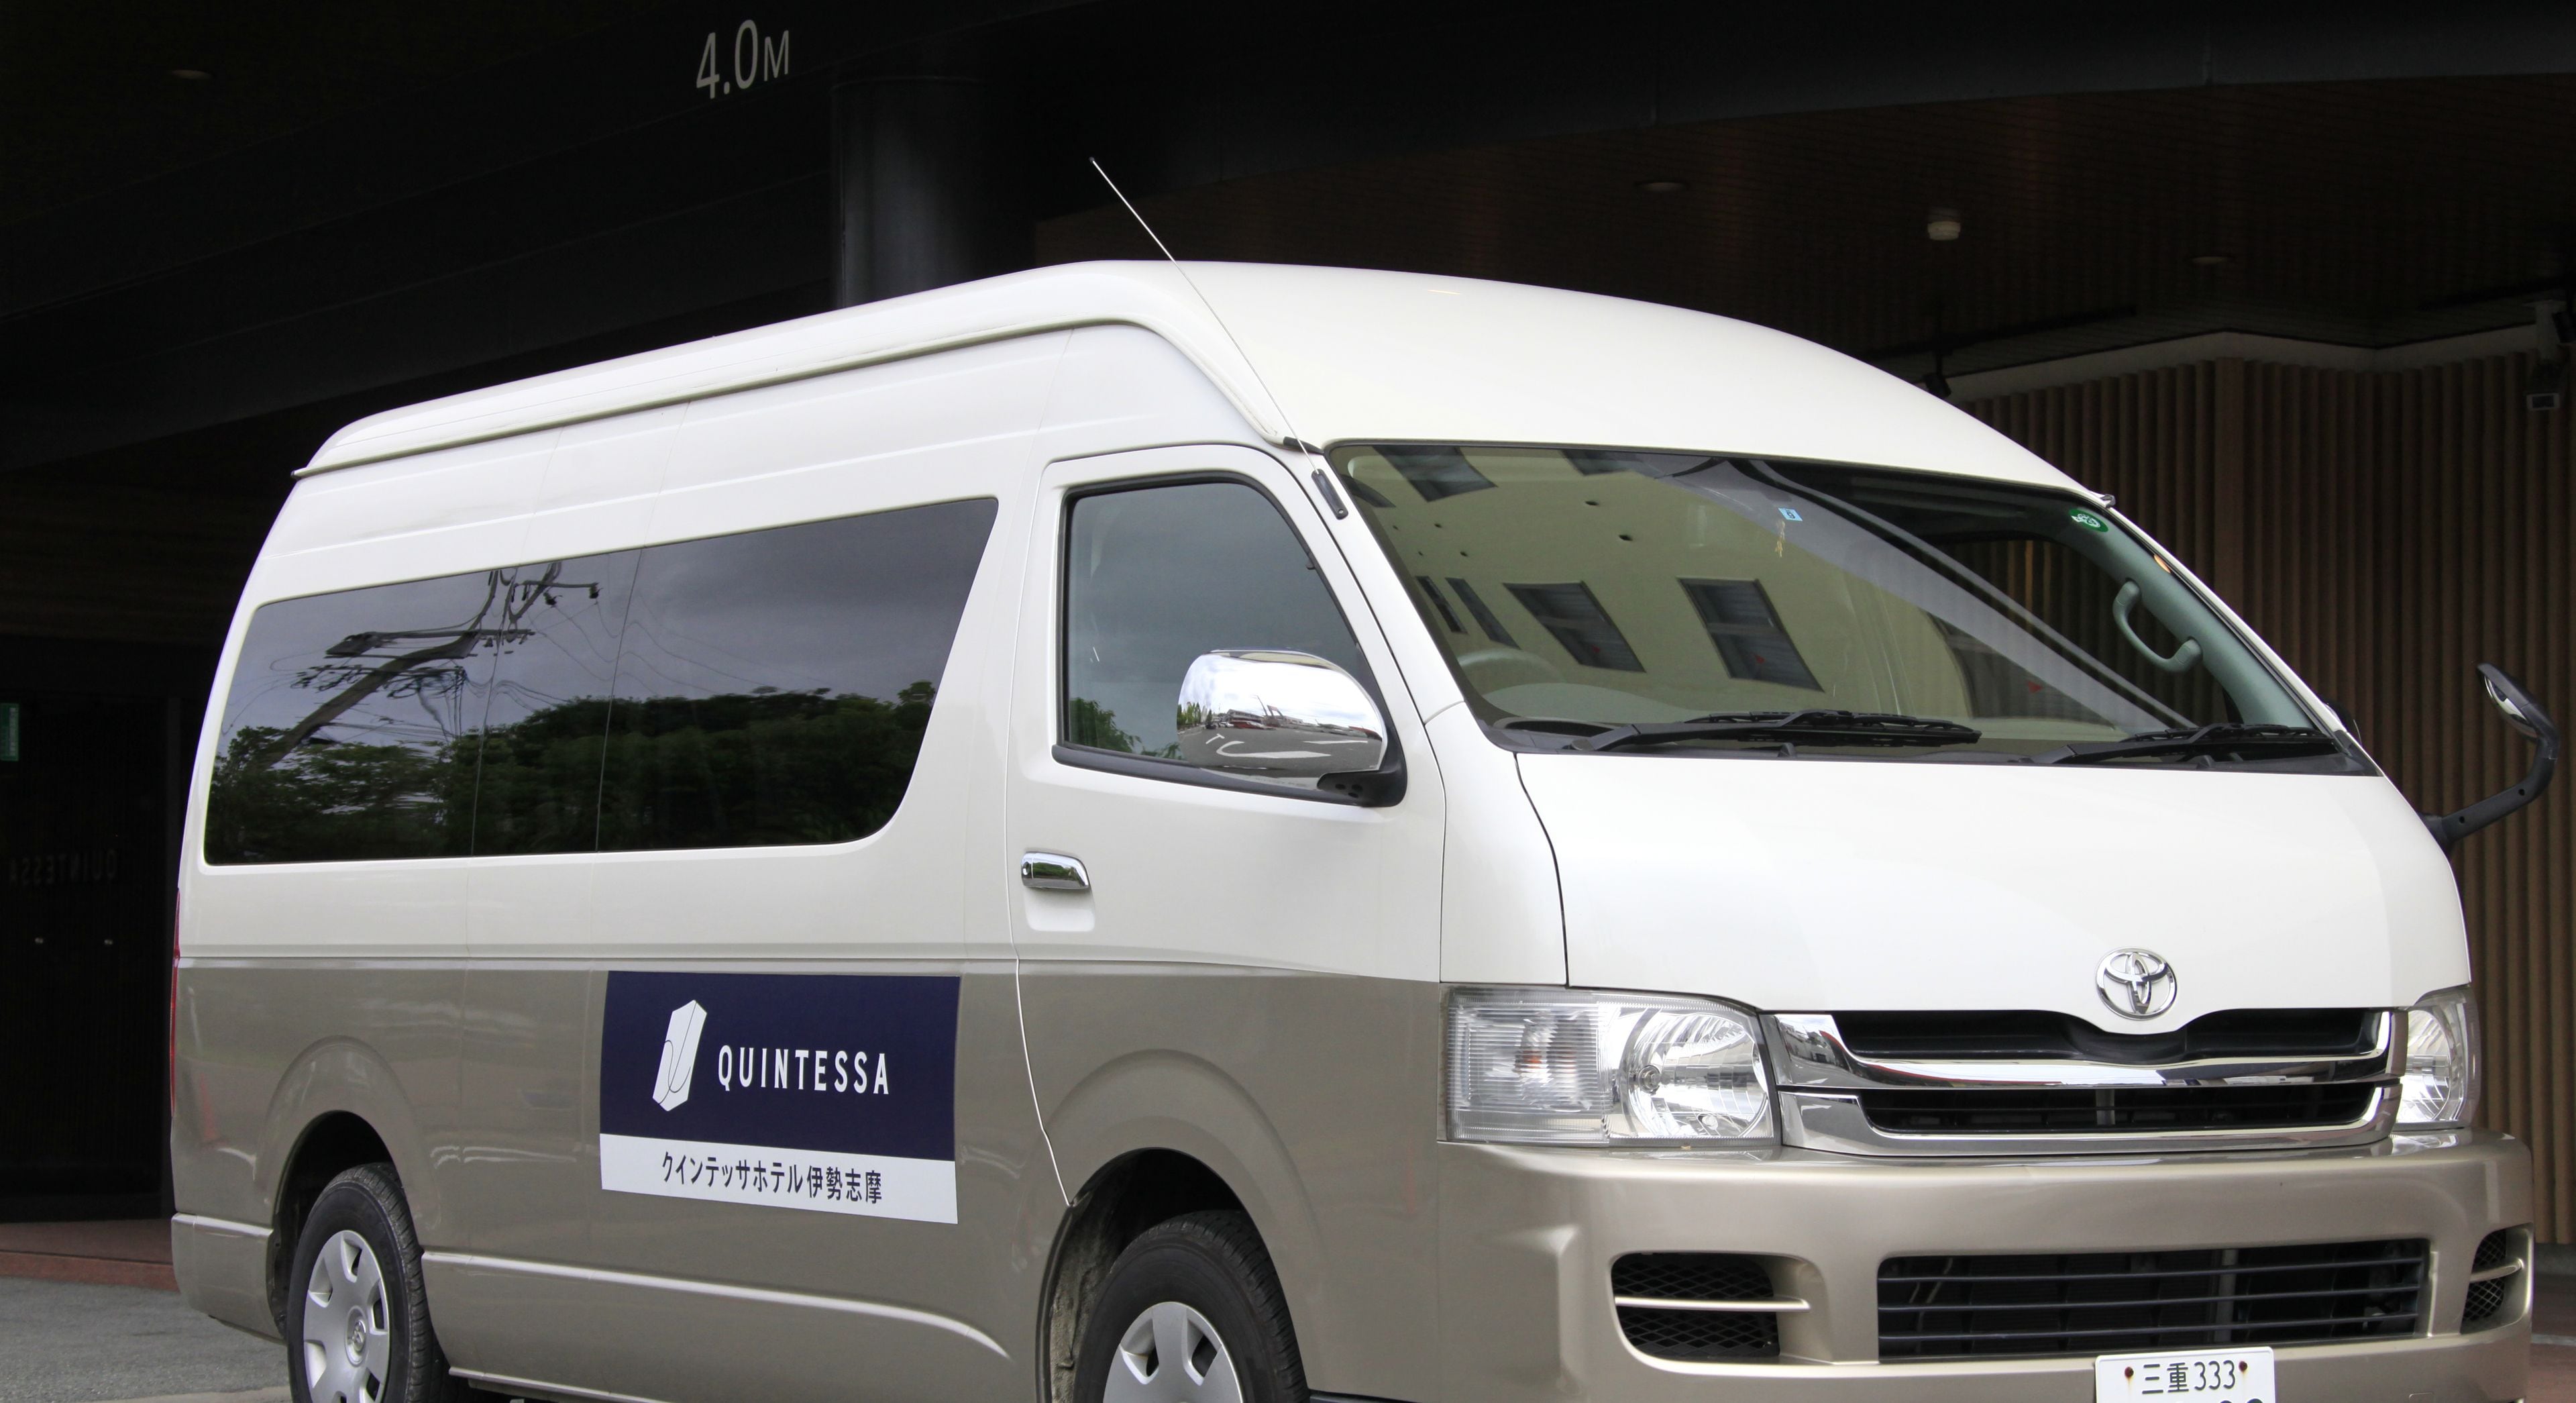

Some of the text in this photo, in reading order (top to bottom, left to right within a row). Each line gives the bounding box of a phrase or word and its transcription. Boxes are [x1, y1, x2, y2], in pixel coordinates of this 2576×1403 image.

[718, 1045, 889, 1095] QUINTESSA
[662, 1151, 882, 1204] クインテッサホテル伊勢志摩
